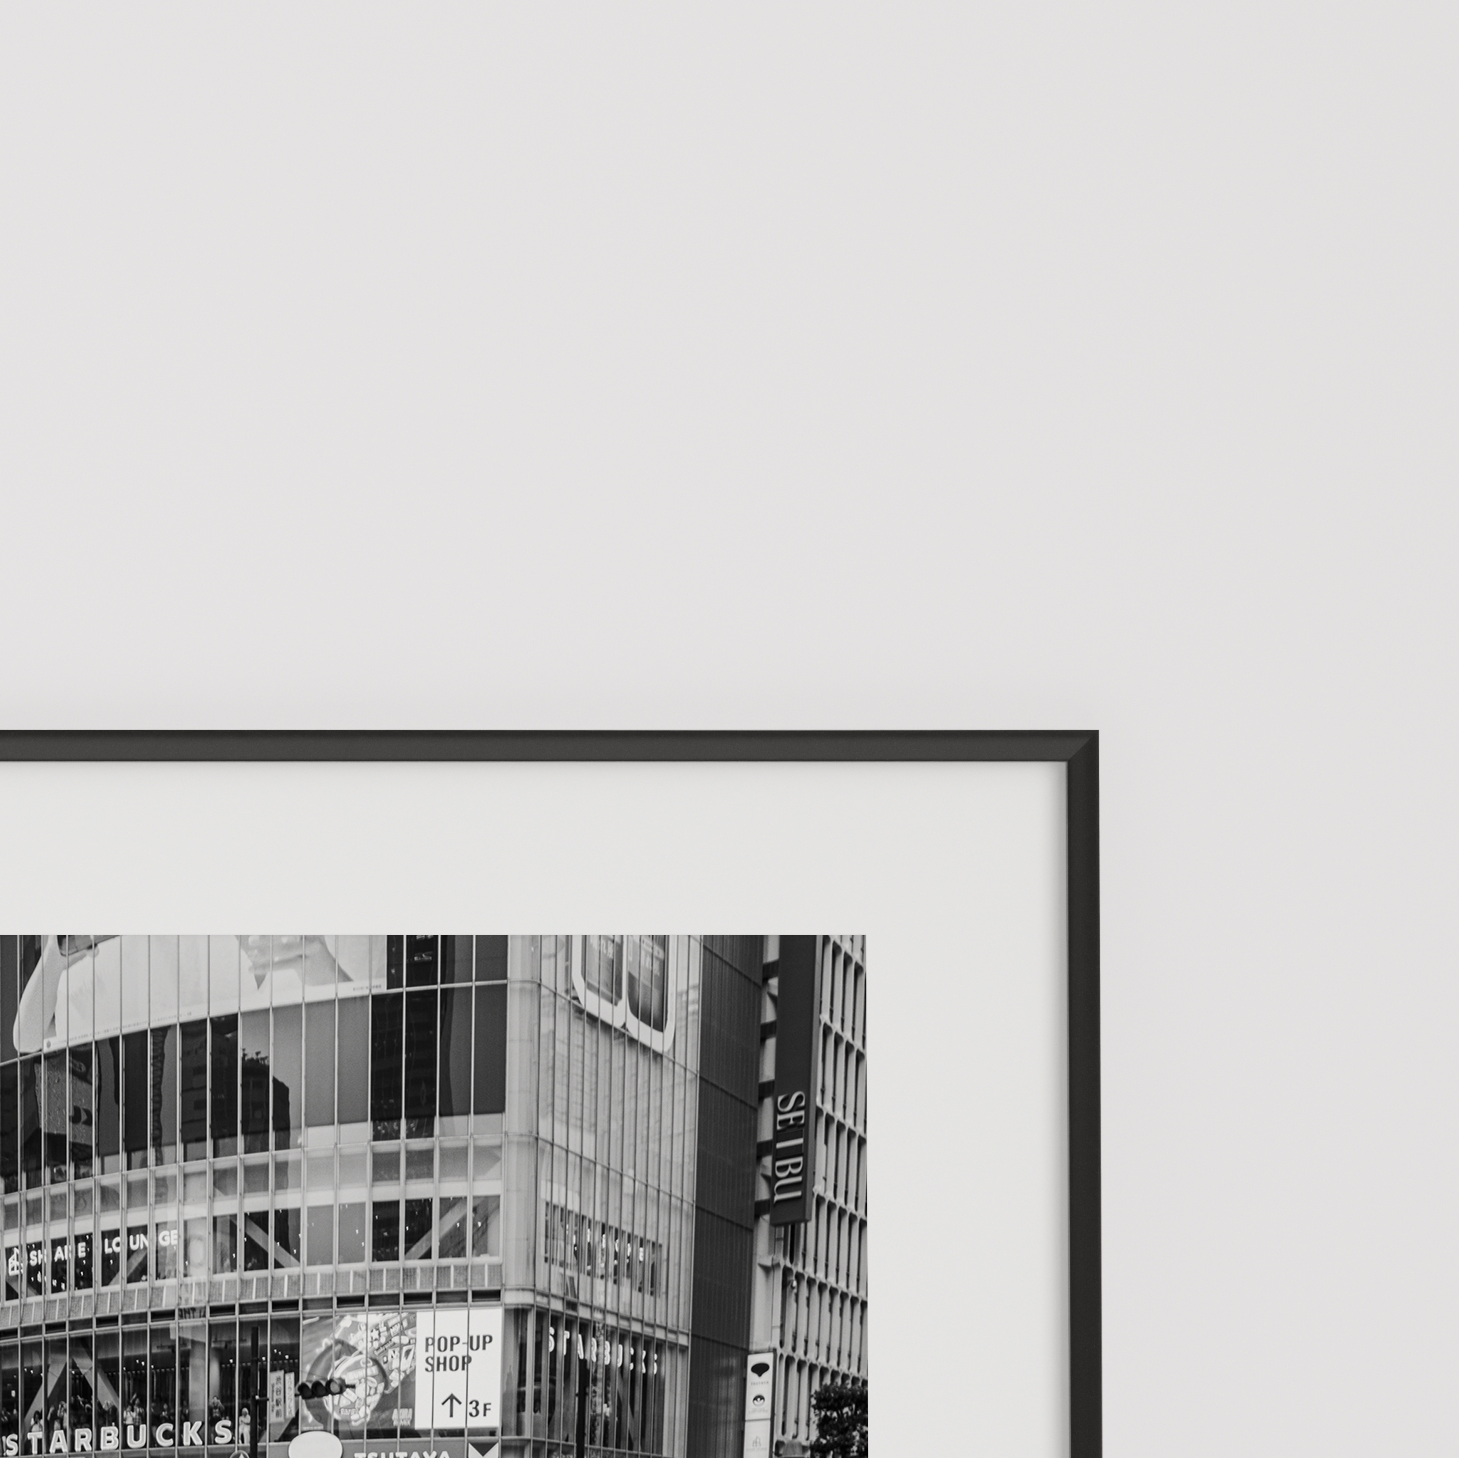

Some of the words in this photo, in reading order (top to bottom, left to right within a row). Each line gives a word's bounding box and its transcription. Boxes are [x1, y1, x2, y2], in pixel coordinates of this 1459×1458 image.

[774, 1091, 806, 1203] SEIBU
[424, 1334, 493, 1353] POP-UP
[424, 1355, 473, 1373] SHOP
[468, 1399, 492, 1418] 3F
[5, 1419, 233, 1458] STARBUCKS
